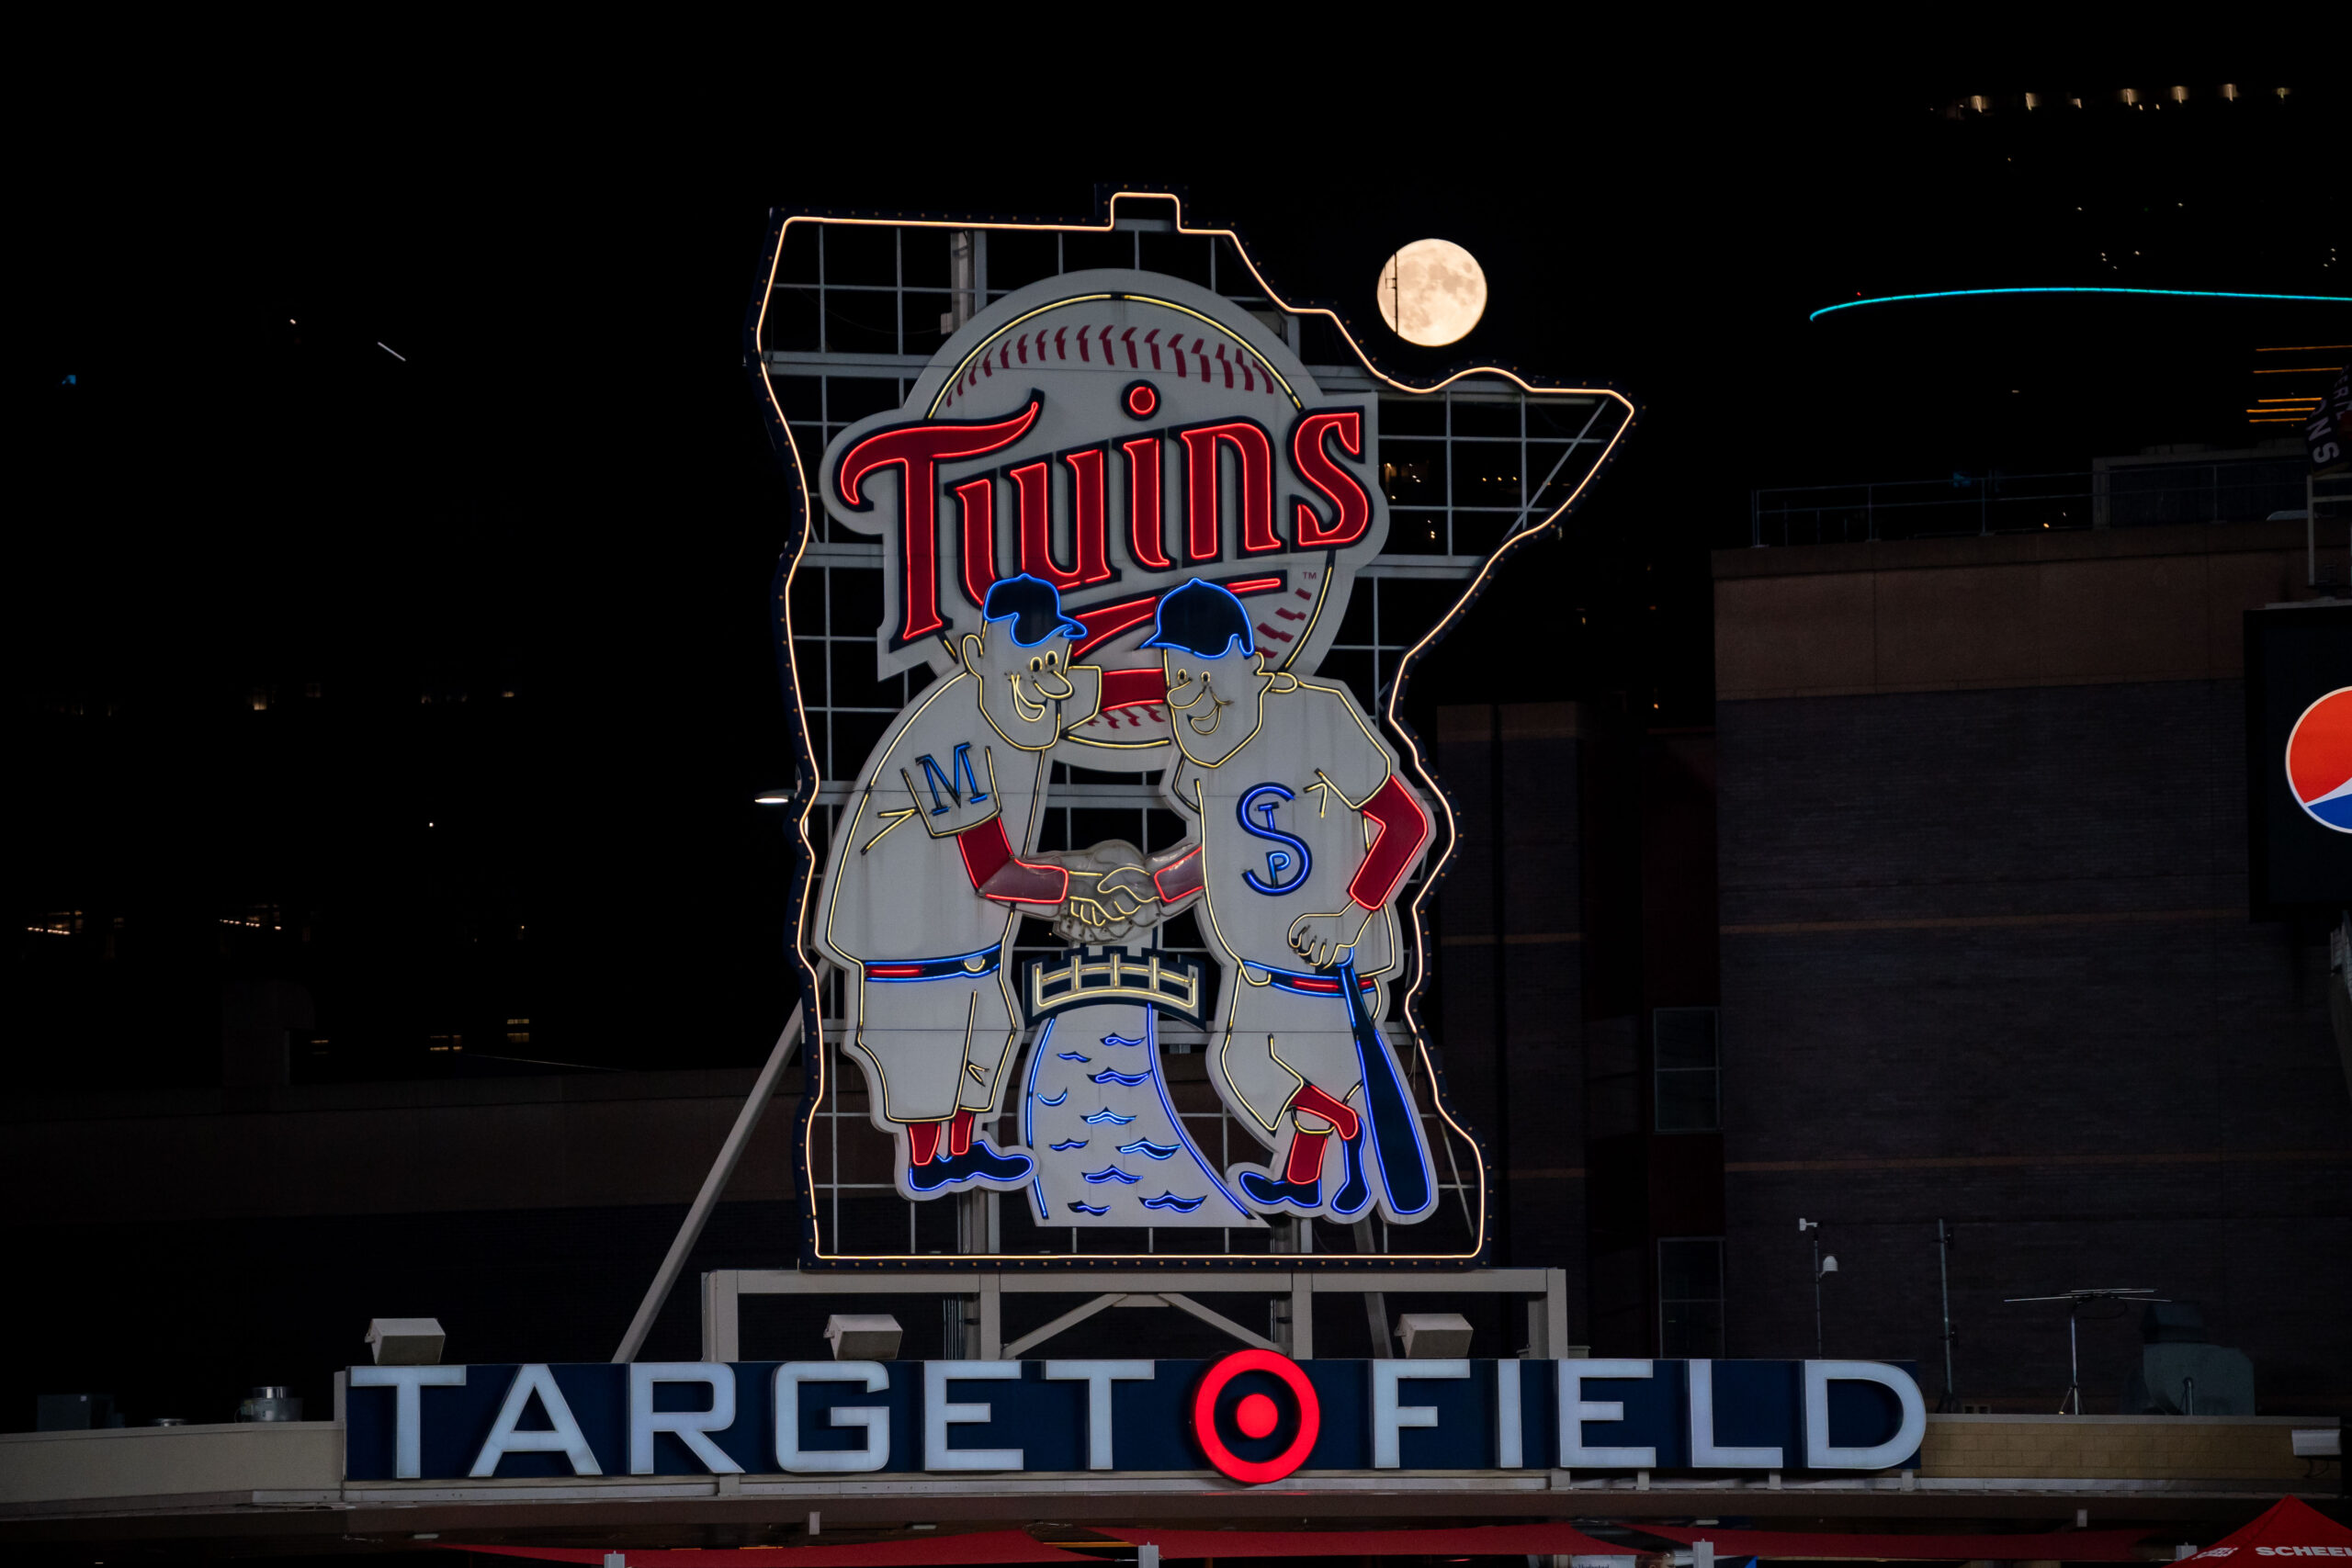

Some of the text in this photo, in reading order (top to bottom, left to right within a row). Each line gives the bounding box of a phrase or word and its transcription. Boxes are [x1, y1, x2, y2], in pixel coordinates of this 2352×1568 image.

[835, 380, 1374, 651] Twins
[1303, 571, 1317, 580] TM
[916, 741, 989, 816] M
[349, 1359, 1928, 1480] TARGET FIELD
